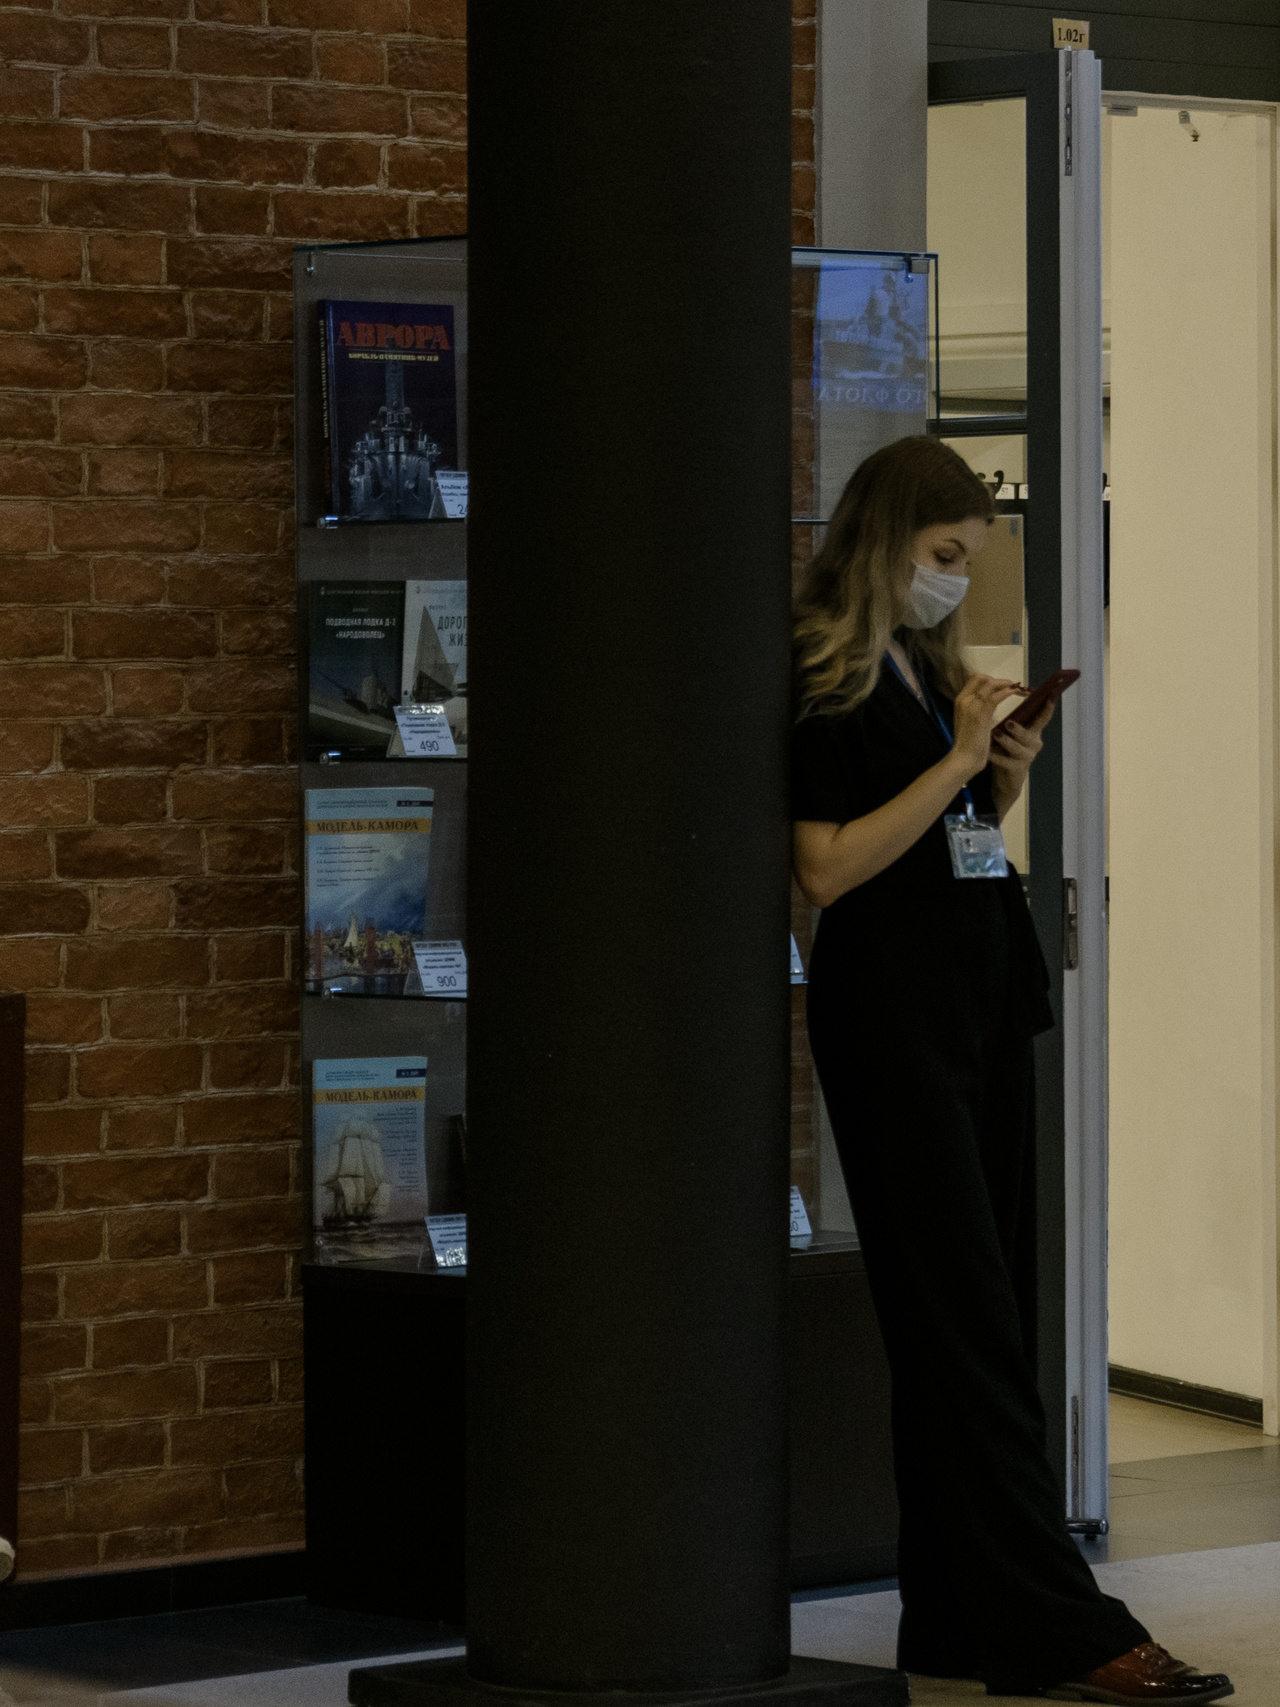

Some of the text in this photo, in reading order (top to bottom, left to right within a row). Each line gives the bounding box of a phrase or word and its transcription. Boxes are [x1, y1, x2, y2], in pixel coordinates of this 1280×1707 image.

[335, 320, 451, 351] АВРОРА
[325, 617, 362, 627] ПОДВОДНАЯ
[362, 617, 383, 627] ЛОДКА
[448, 632, 467, 647] ЖИ
[420, 740, 439, 752] 490
[316, 819, 419, 833] МОДЕЛЬ-КАМОРА
[436, 975, 457, 988] 900
[325, 1088, 418, 1103] МОДЕЛЬ-КАМОРА
